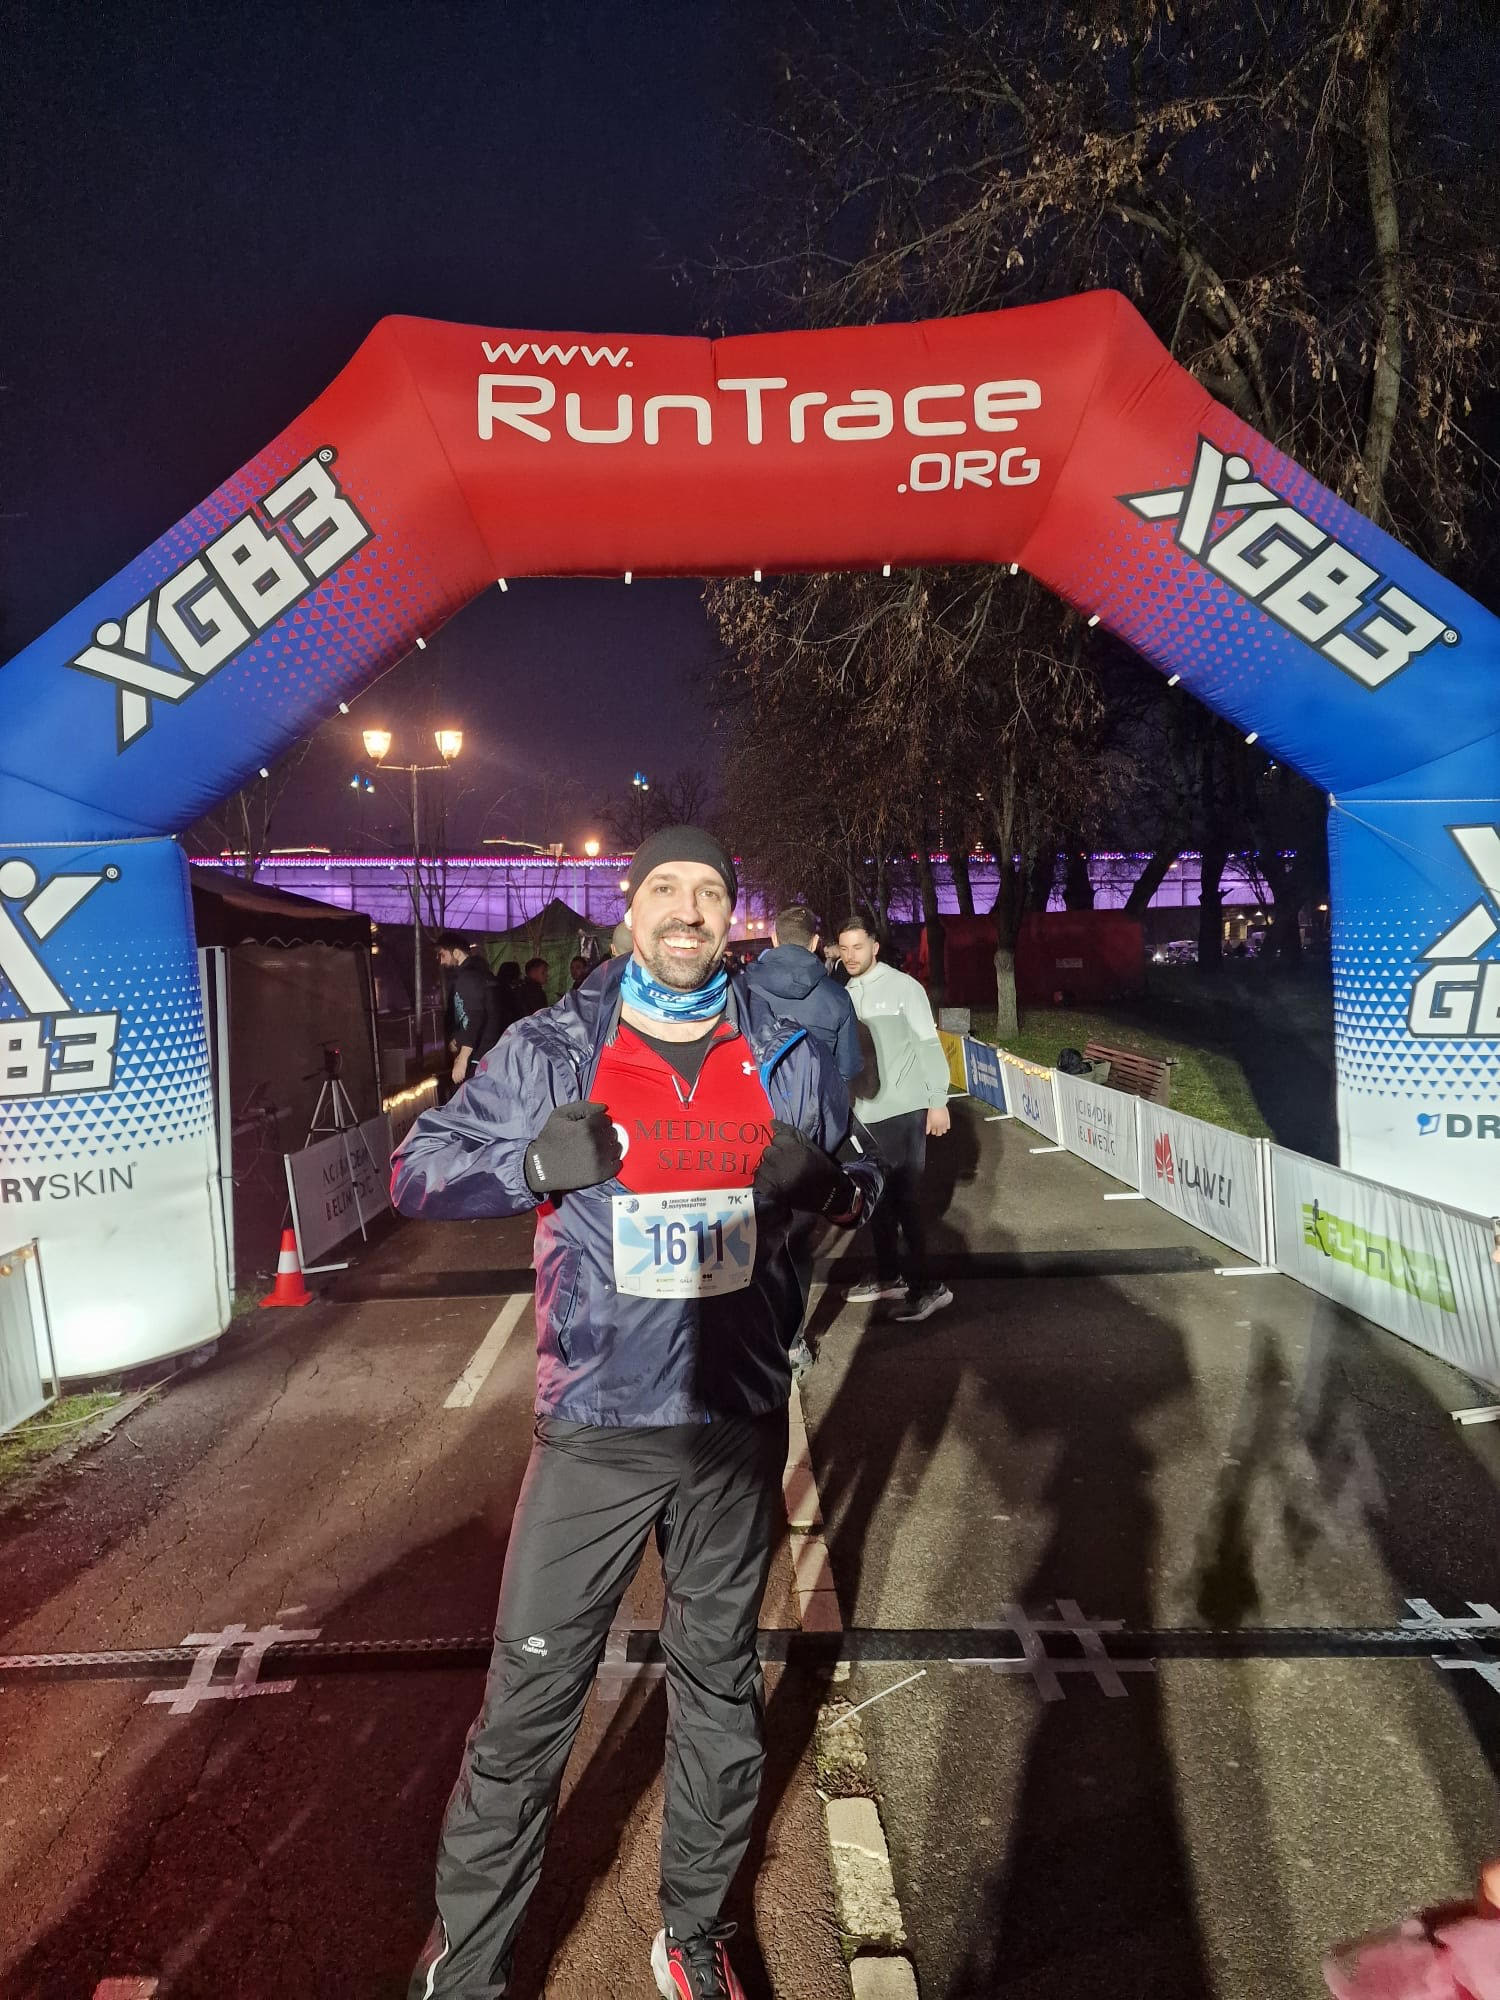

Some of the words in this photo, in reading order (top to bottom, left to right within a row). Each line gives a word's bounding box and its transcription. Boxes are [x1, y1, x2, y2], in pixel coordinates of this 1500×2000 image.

[481, 340, 634, 368] www.
[477, 373, 1042, 446] RunTrace
[896, 446, 1041, 494] .ORG
[728, 1196, 742, 1205] 7K
[645, 1219, 724, 1266] 1611
